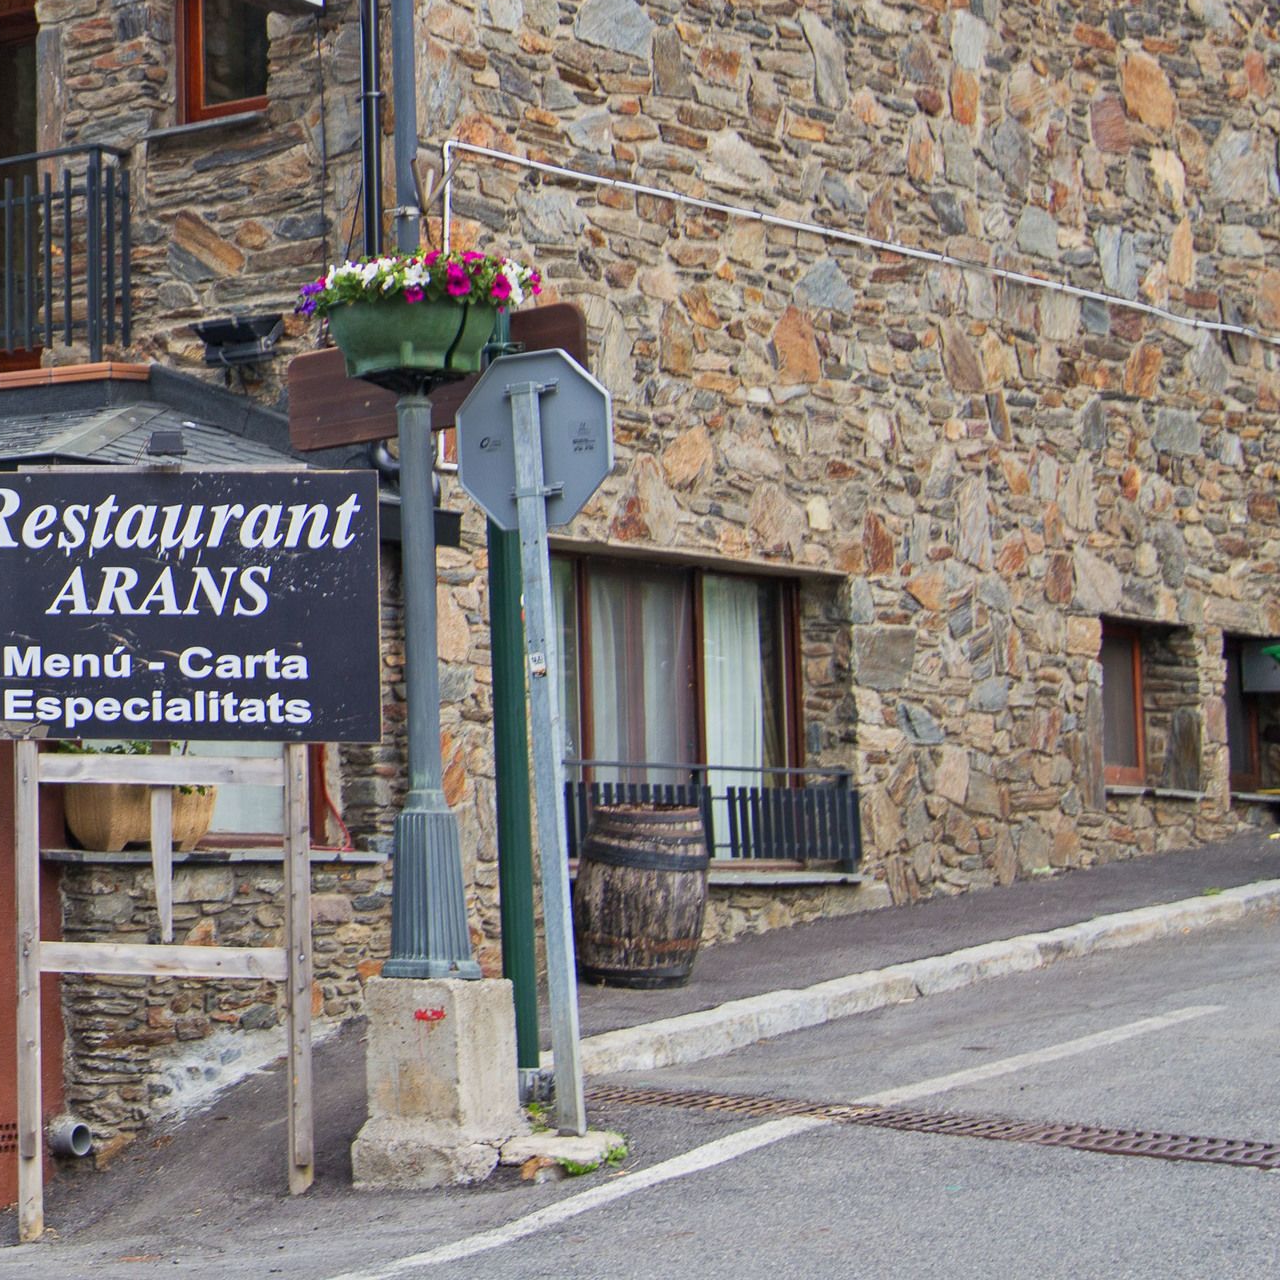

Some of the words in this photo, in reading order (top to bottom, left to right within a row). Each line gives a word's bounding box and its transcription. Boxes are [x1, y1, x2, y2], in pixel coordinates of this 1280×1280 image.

[44, 565, 272, 618] ARANS
[3, 645, 132, 680] Menú
[178, 646, 309, 680] Carta
[3, 688, 313, 729] Especialitats
